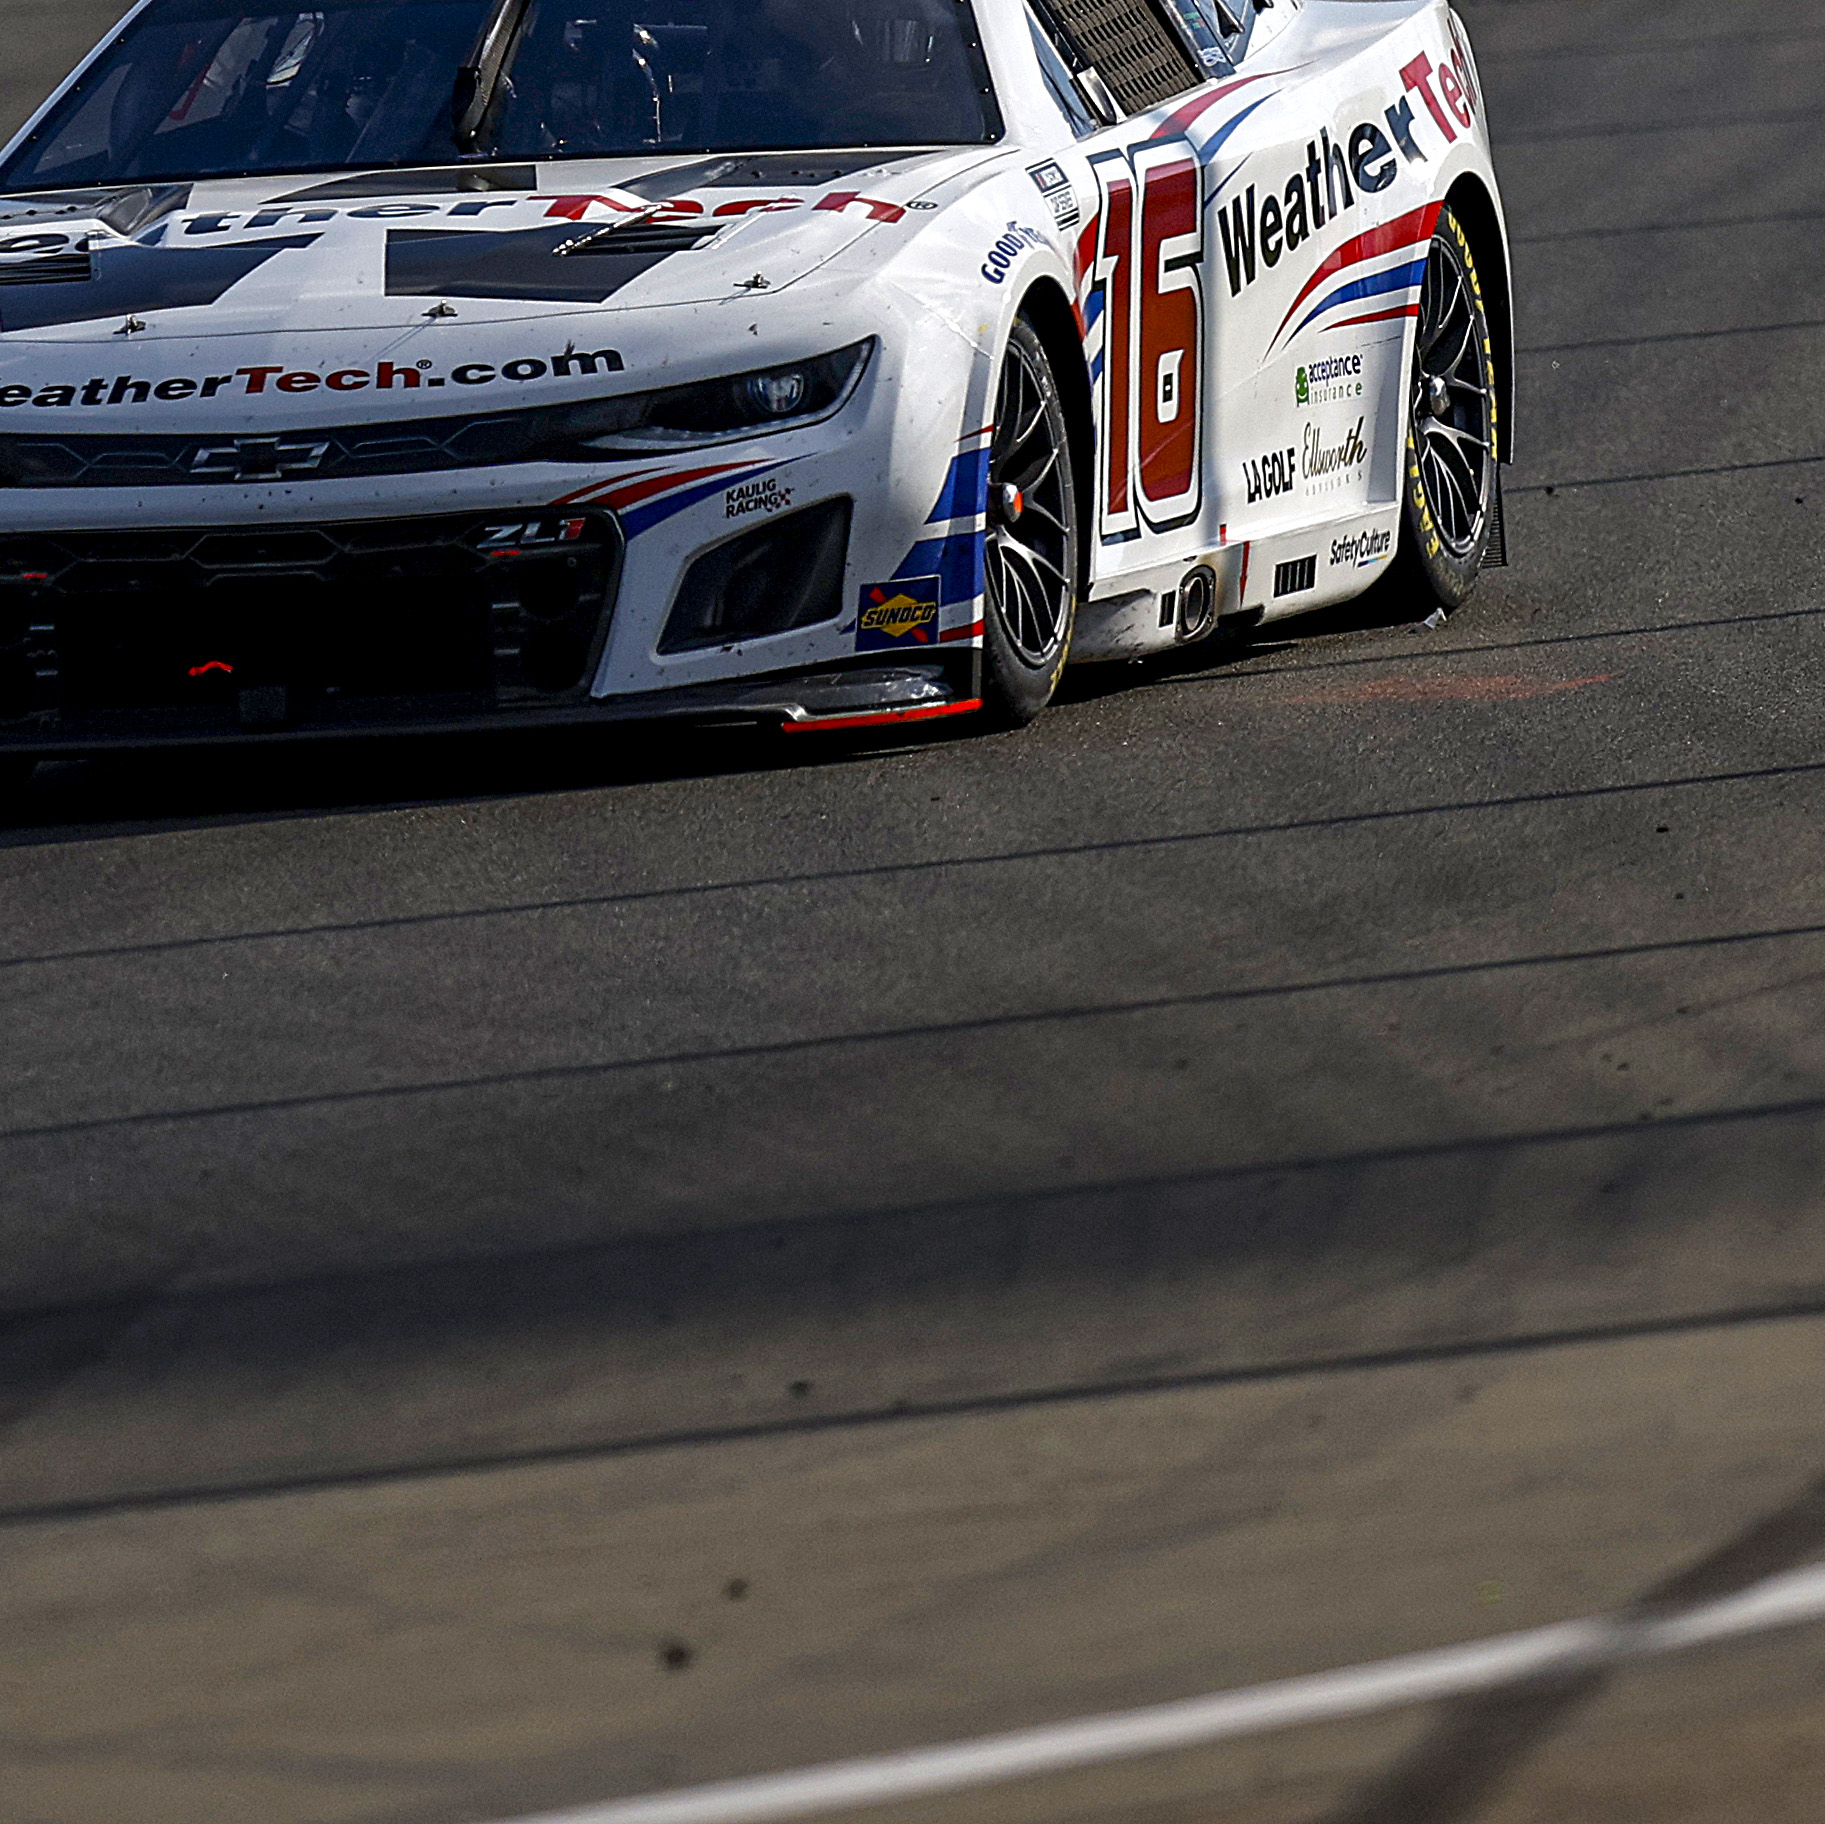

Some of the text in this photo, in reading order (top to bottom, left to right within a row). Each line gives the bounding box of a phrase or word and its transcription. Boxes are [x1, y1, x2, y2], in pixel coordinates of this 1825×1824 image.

[1100, 148, 1203, 536] 16
[1308, 354, 1362, 387] acceptance
[1310, 381, 1363, 405] insurance
[1301, 415, 1368, 479] Ellsworth
[726, 478, 777, 504] KAULIG
[726, 492, 778, 519] RACING
[476, 517, 586, 549] ZL1
[1330, 528, 1391, 569] SafetyCulture
[864, 604, 936, 627] SUNOCO
